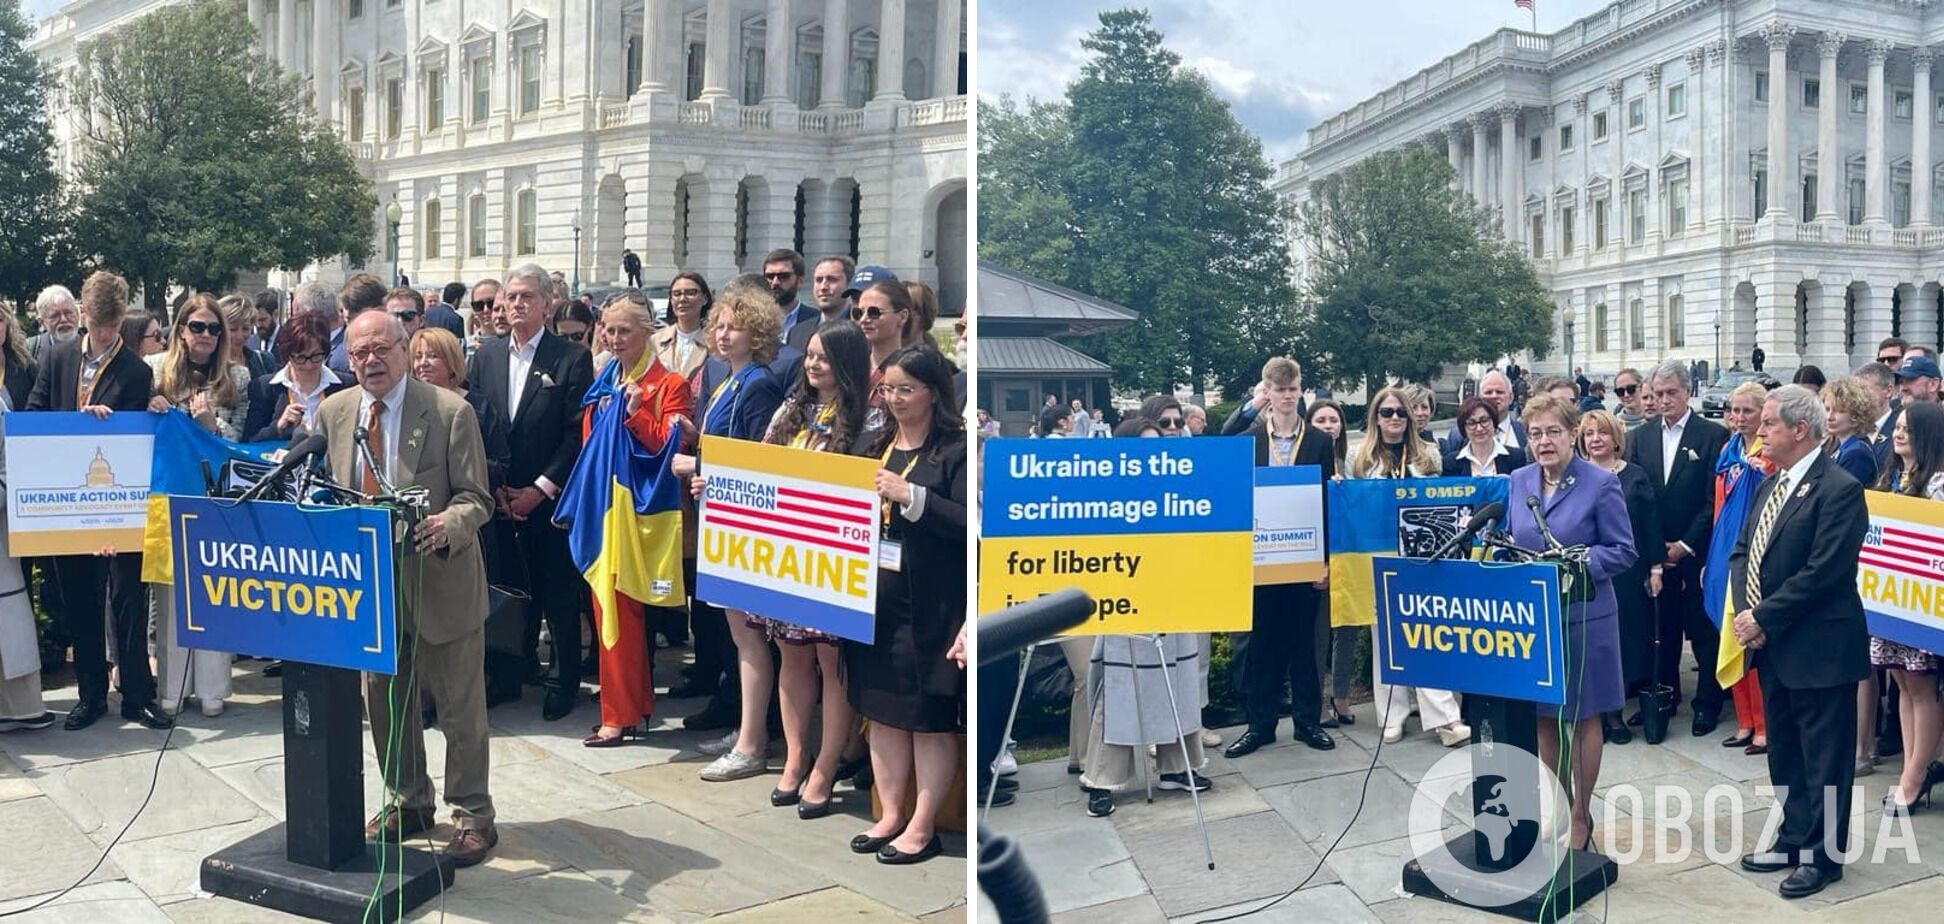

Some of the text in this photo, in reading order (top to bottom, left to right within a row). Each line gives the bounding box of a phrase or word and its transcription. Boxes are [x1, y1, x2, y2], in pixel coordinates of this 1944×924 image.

[1010, 452, 1193, 479] Ukraine is the
[19, 492, 77, 504] UKRAINE
[79, 491, 127, 502] ACTION
[706, 475, 776, 498] AMERICAN
[706, 487, 776, 511] COALITION
[1395, 487, 1417, 500] 93
[1008, 493, 1212, 523] scrimmage line
[842, 526, 871, 543] FOR
[1271, 531, 1313, 542] SUMMIT
[199, 540, 362, 581] UKRAINIAN
[703, 527, 869, 599] UKRAINE
[1007, 550, 1142, 578] for liberty
[202, 574, 363, 621] VICTORY
[1398, 593, 1536, 627] UKRAINIAN
[1401, 622, 1537, 660] VICTORY
